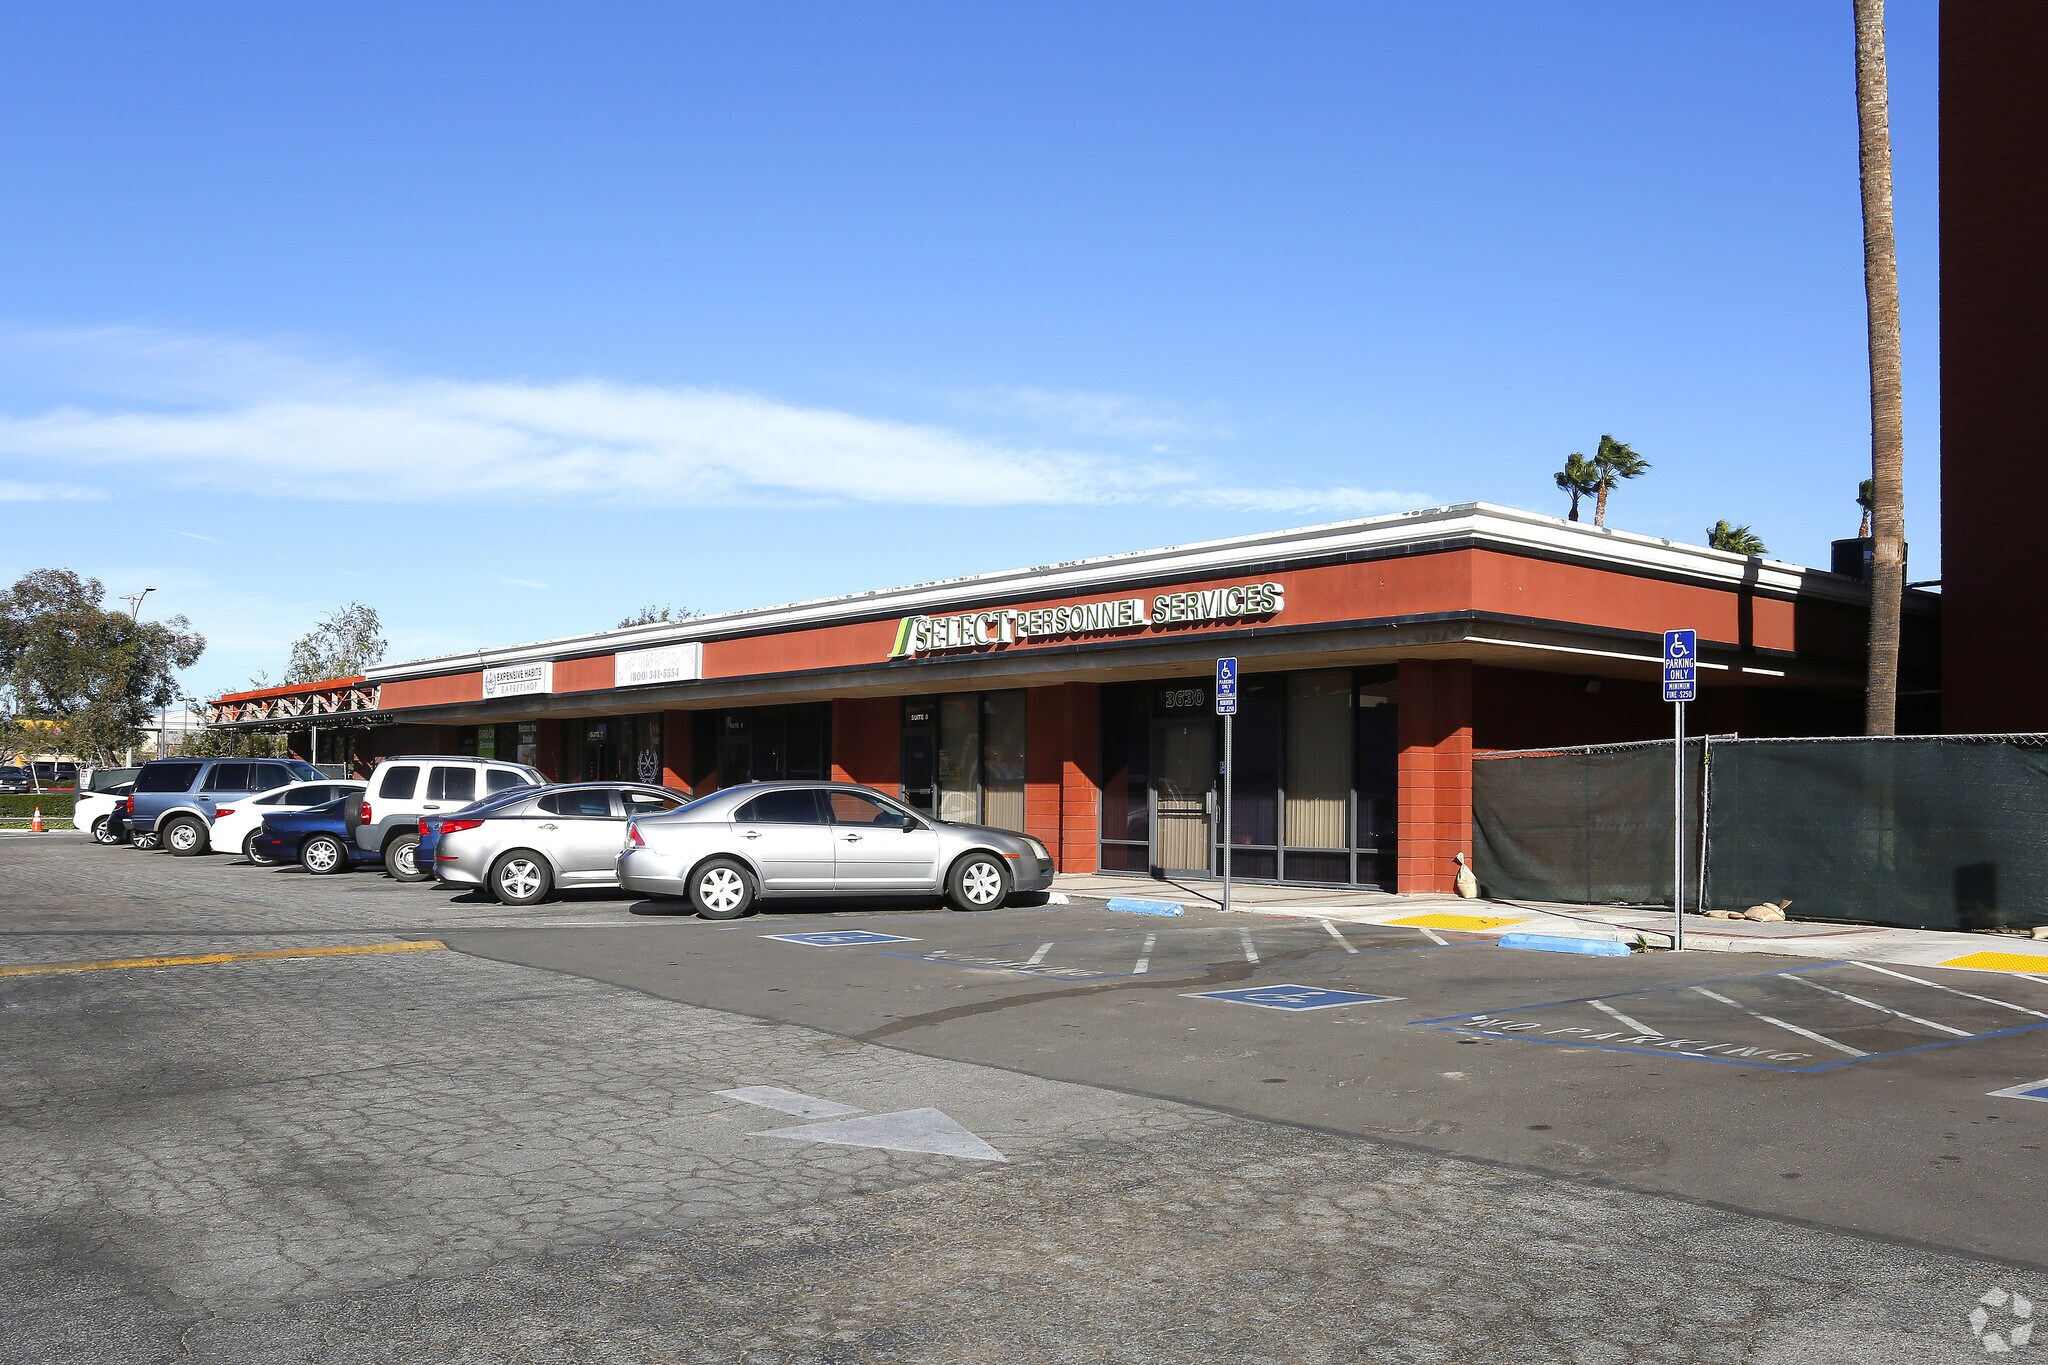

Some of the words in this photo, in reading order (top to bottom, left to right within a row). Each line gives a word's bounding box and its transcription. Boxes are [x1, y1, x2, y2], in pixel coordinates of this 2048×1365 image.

[915, 610, 1013, 652] SELECT
[1015, 599, 1148, 638] PERSONNEL
[1152, 582, 1284, 624] SERVICES
[1665, 658, 1694, 669] PARKING
[496, 669, 524, 682] EXPENSIVE
[524, 667, 542, 678] HABITS
[630, 670, 648, 682] (800)
[648, 668, 680, 680] 341-5554
[1670, 669, 1689, 680] ONLY
[500, 682, 538, 693] BARBERSHOP
[1165, 689, 1205, 708] 3630
[480, 740, 495, 749] Braces
[1464, 1017, 1541, 1031] NO
[1544, 1027, 1813, 1061] PARKING
